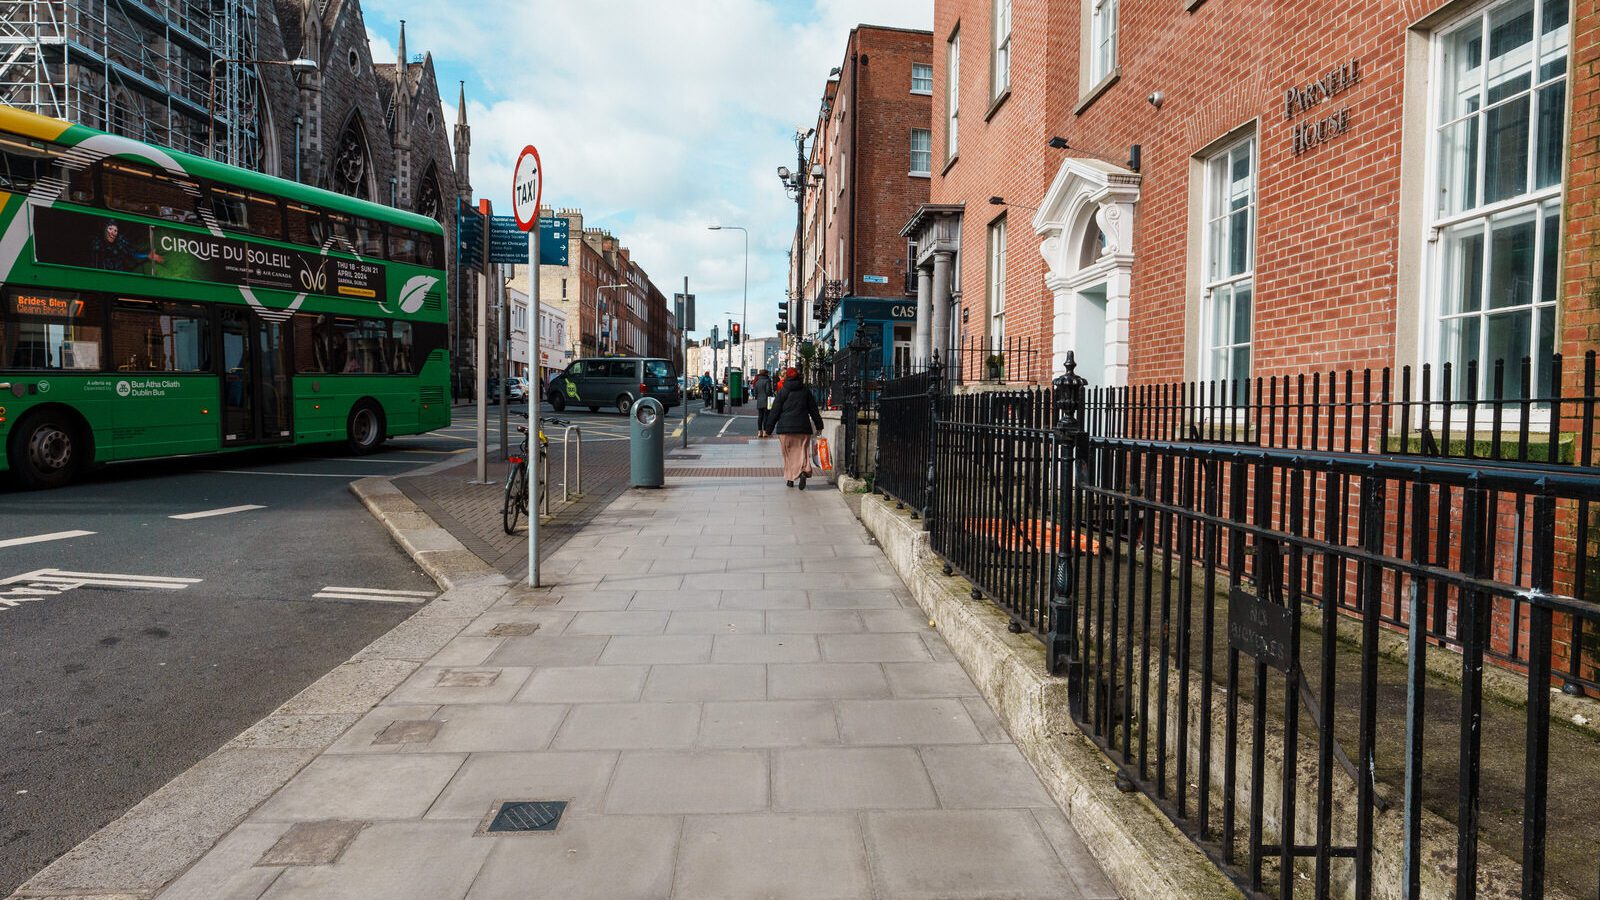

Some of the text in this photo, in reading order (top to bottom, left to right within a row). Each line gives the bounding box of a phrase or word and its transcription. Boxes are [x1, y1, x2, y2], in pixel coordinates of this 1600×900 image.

[1284, 57, 1359, 119] PARNELL
[1291, 104, 1350, 154] HOUSE
[517, 179, 536, 207] TAXI
[161, 236, 291, 269] CIRQUE DU SOLEIL
[271, 271, 291, 279] CANADA
[337, 261, 348, 270] THU
[361, 265, 372, 273] SUN
[337, 270, 368, 280] APRIL 2024
[49, 298, 67, 307] Glen
[75, 300, 85, 317] 7
[131, 380, 145, 388] Bus
